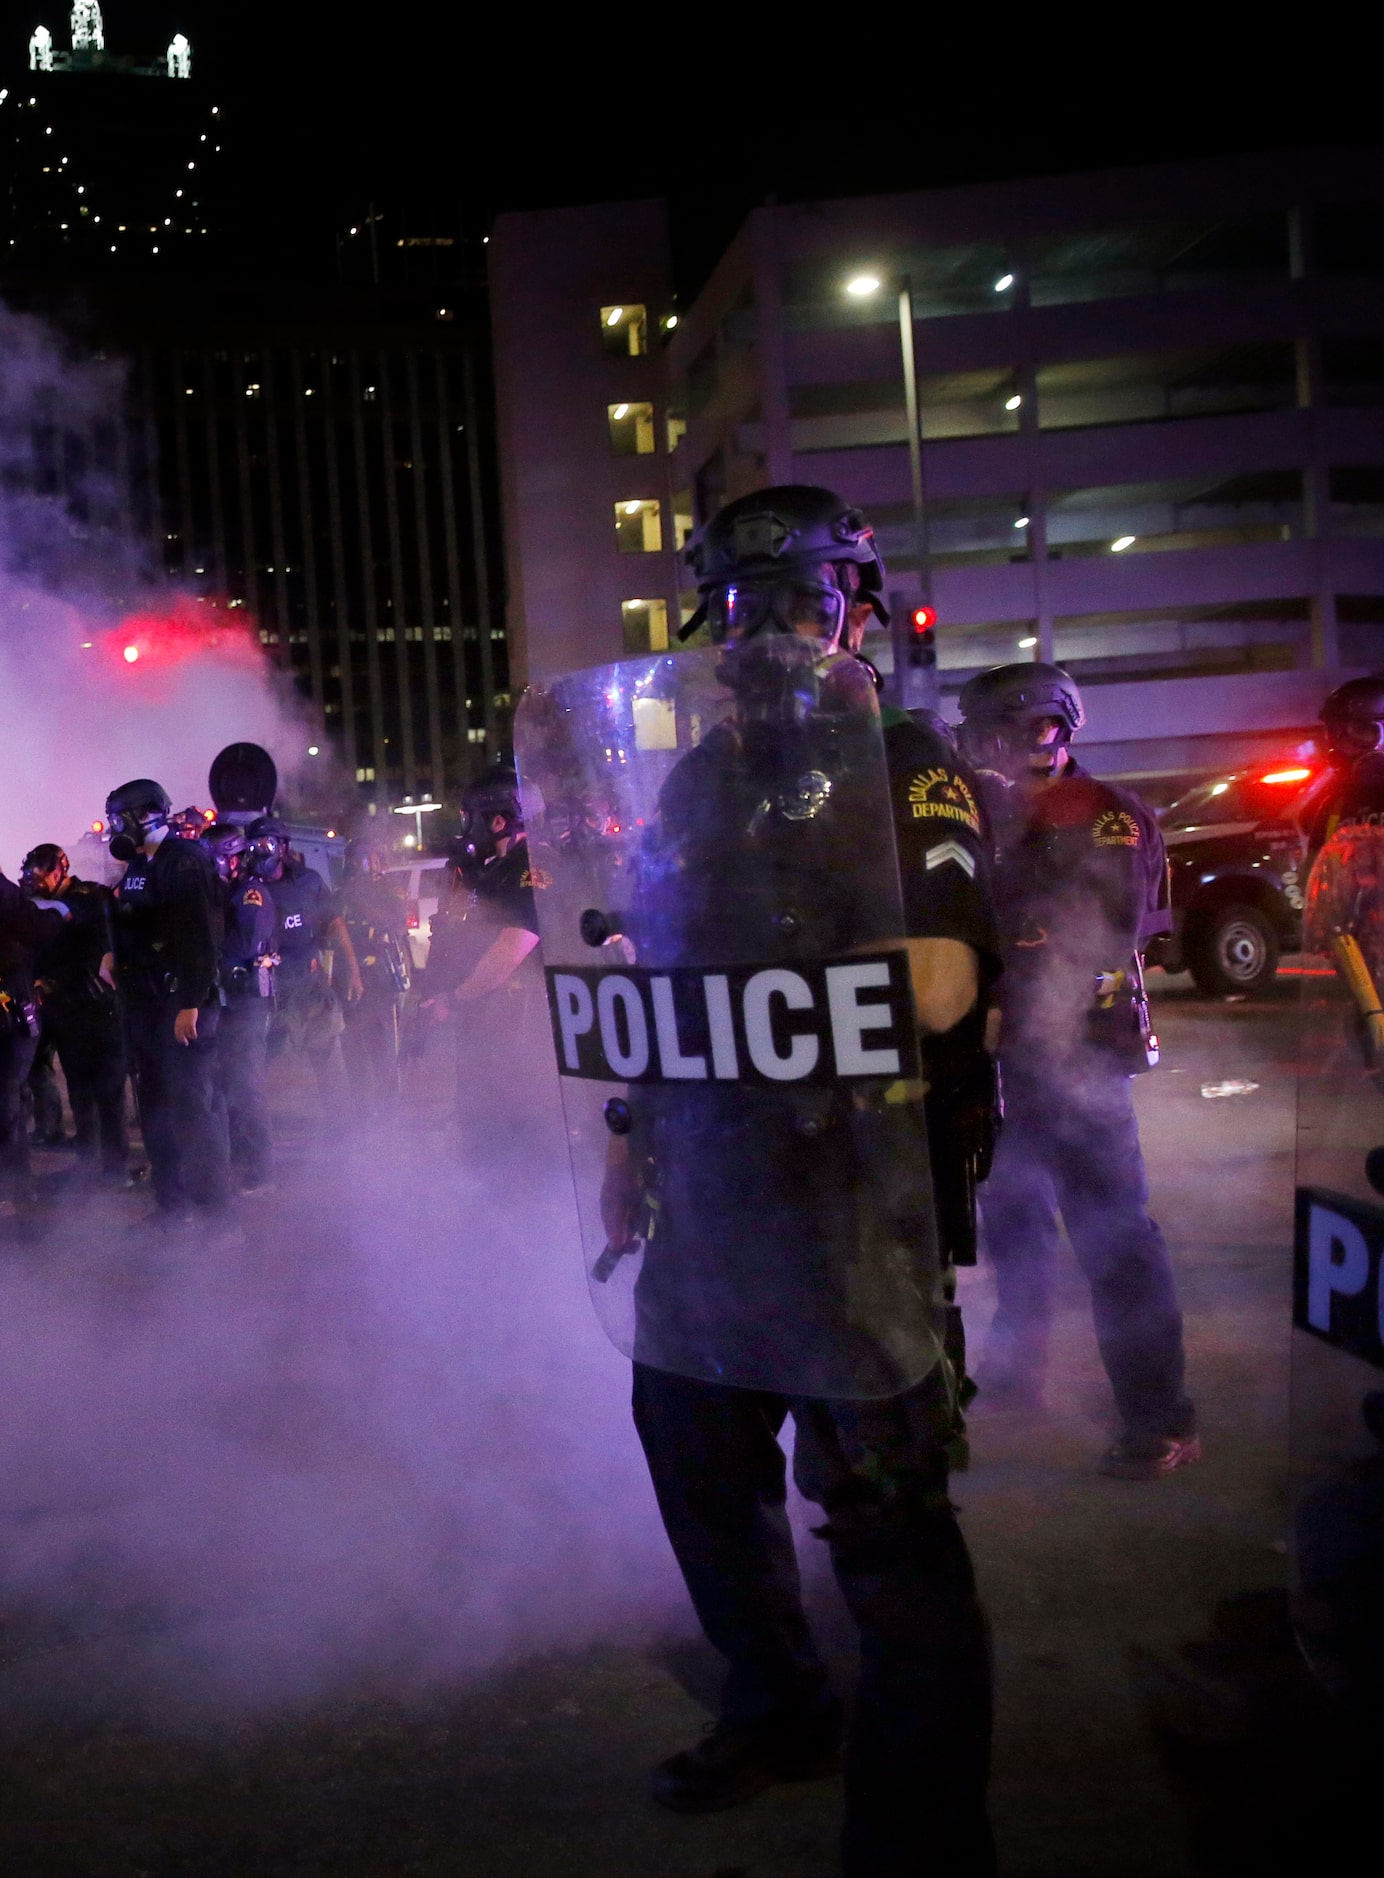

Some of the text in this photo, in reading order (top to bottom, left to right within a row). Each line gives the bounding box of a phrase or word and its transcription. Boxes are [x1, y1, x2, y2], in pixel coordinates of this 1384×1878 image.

[908, 768, 949, 802] DALLAS
[1119, 812, 1140, 837] POLICE
[554, 962, 900, 1081] POLICE
